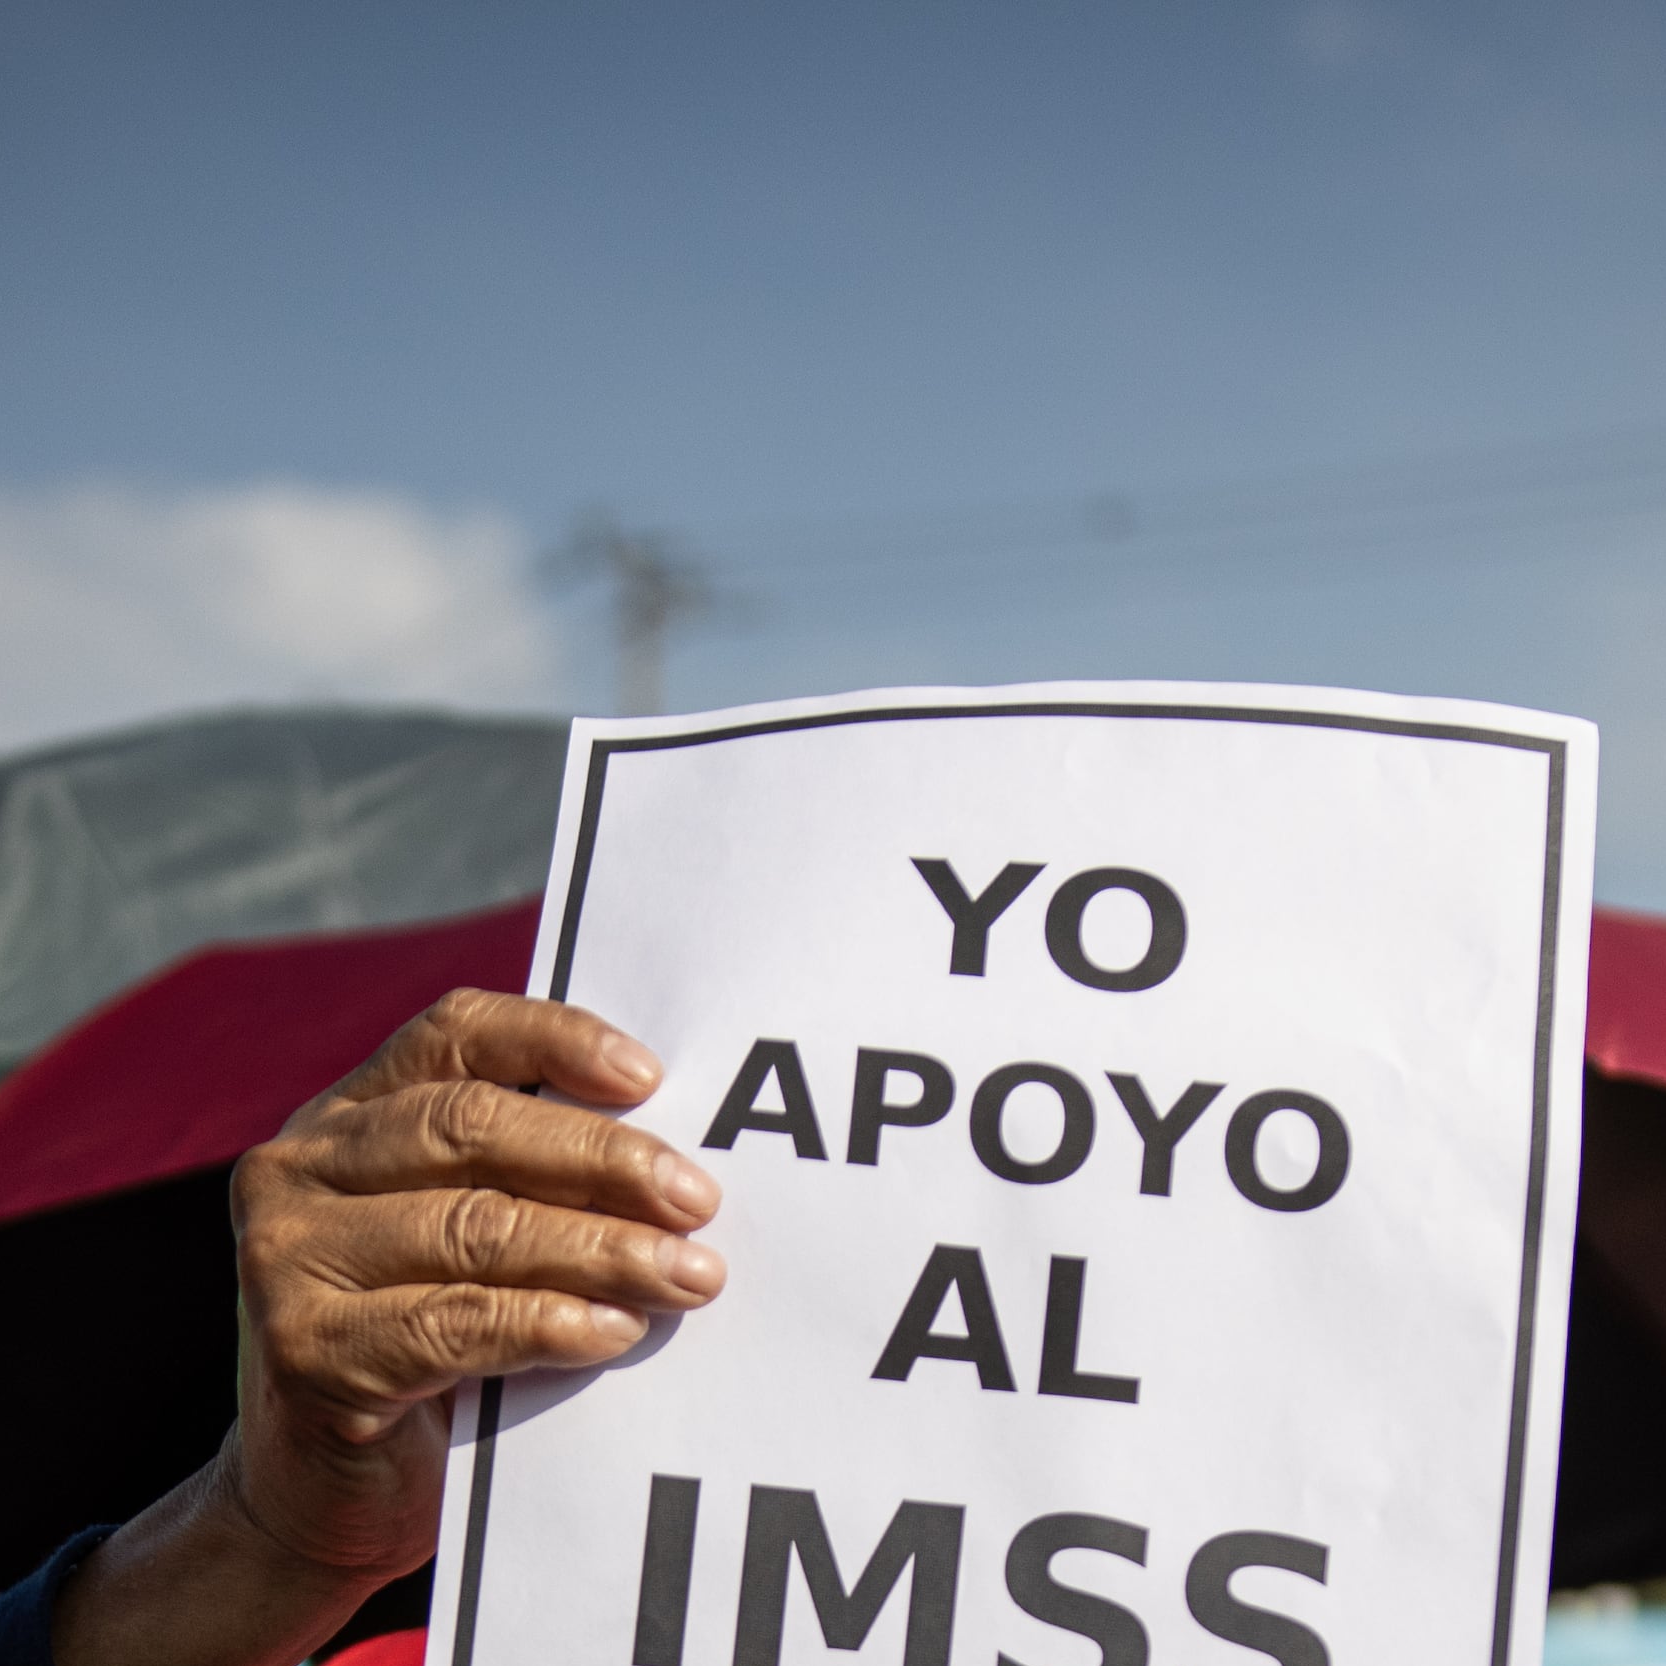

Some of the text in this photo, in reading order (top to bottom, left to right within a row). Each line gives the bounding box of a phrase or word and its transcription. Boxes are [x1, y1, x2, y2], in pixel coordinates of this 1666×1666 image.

[909, 856, 1188, 994] YO
[699, 1038, 1351, 1214] APOYO
[869, 1243, 1141, 1406] AL
